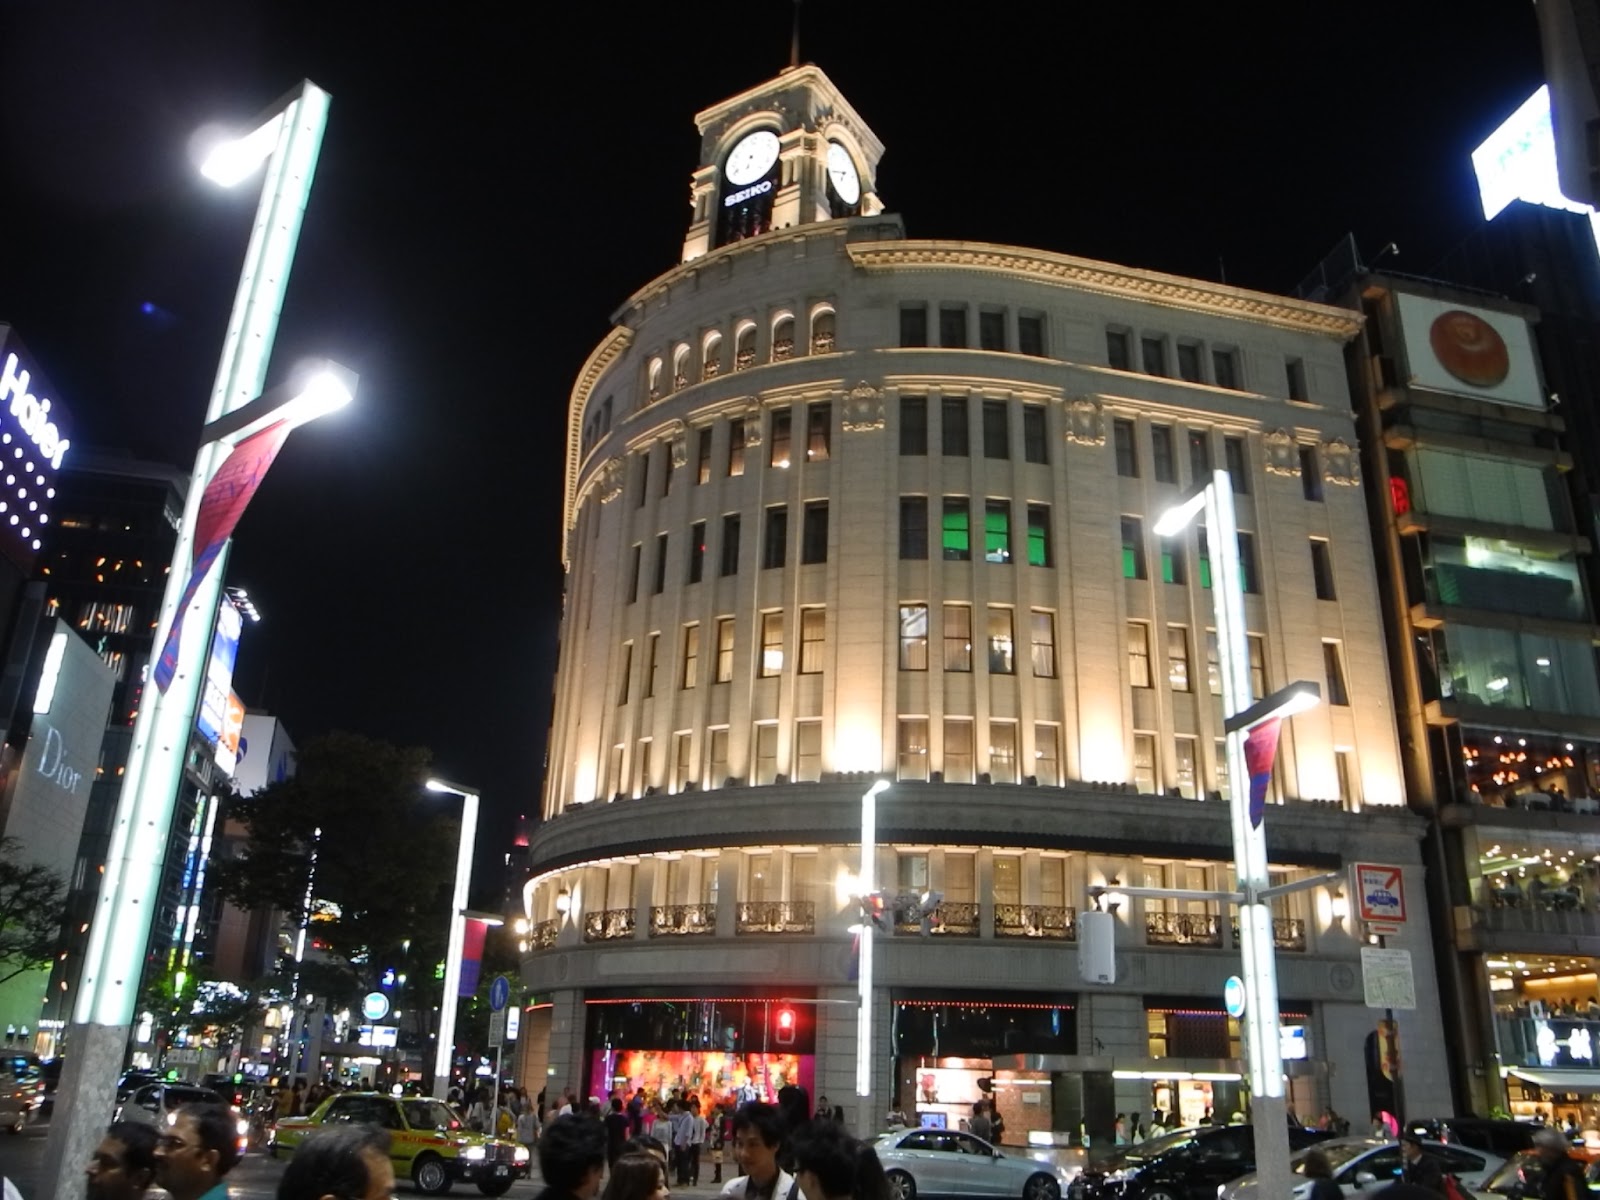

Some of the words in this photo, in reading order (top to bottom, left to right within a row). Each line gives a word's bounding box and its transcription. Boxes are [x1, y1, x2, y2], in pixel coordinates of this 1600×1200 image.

[724, 180, 772, 207] SEIKO
[0, 352, 70, 470] Haier
[38, 726, 82, 795] Dior
